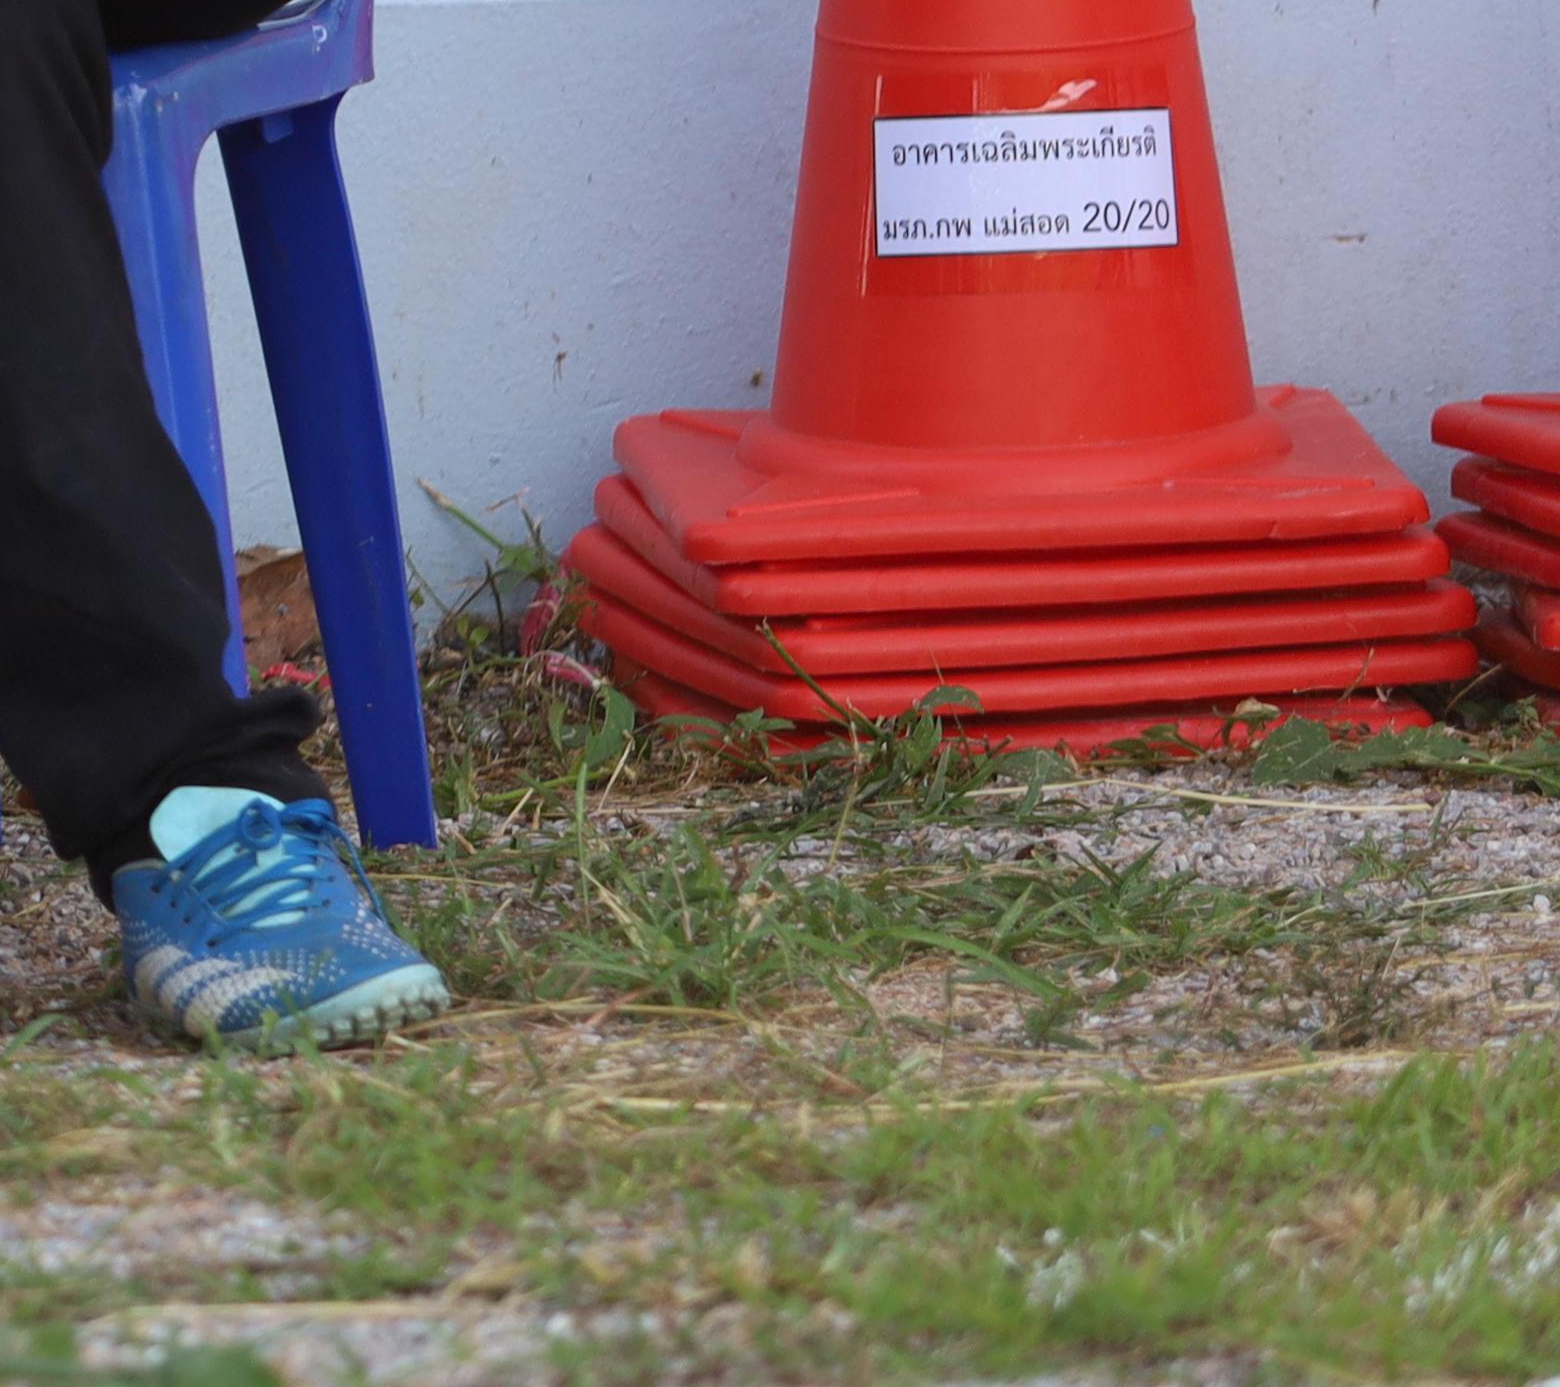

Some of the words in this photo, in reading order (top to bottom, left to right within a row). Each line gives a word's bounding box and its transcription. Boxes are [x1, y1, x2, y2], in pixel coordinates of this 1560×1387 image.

[892, 124, 1157, 166] อาคารเฉลิมพระเกียรติ
[883, 217, 972, 241] มรภ.กพ
[984, 206, 1070, 236] แม่สอด
[1082, 198, 1170, 233] 20/20
